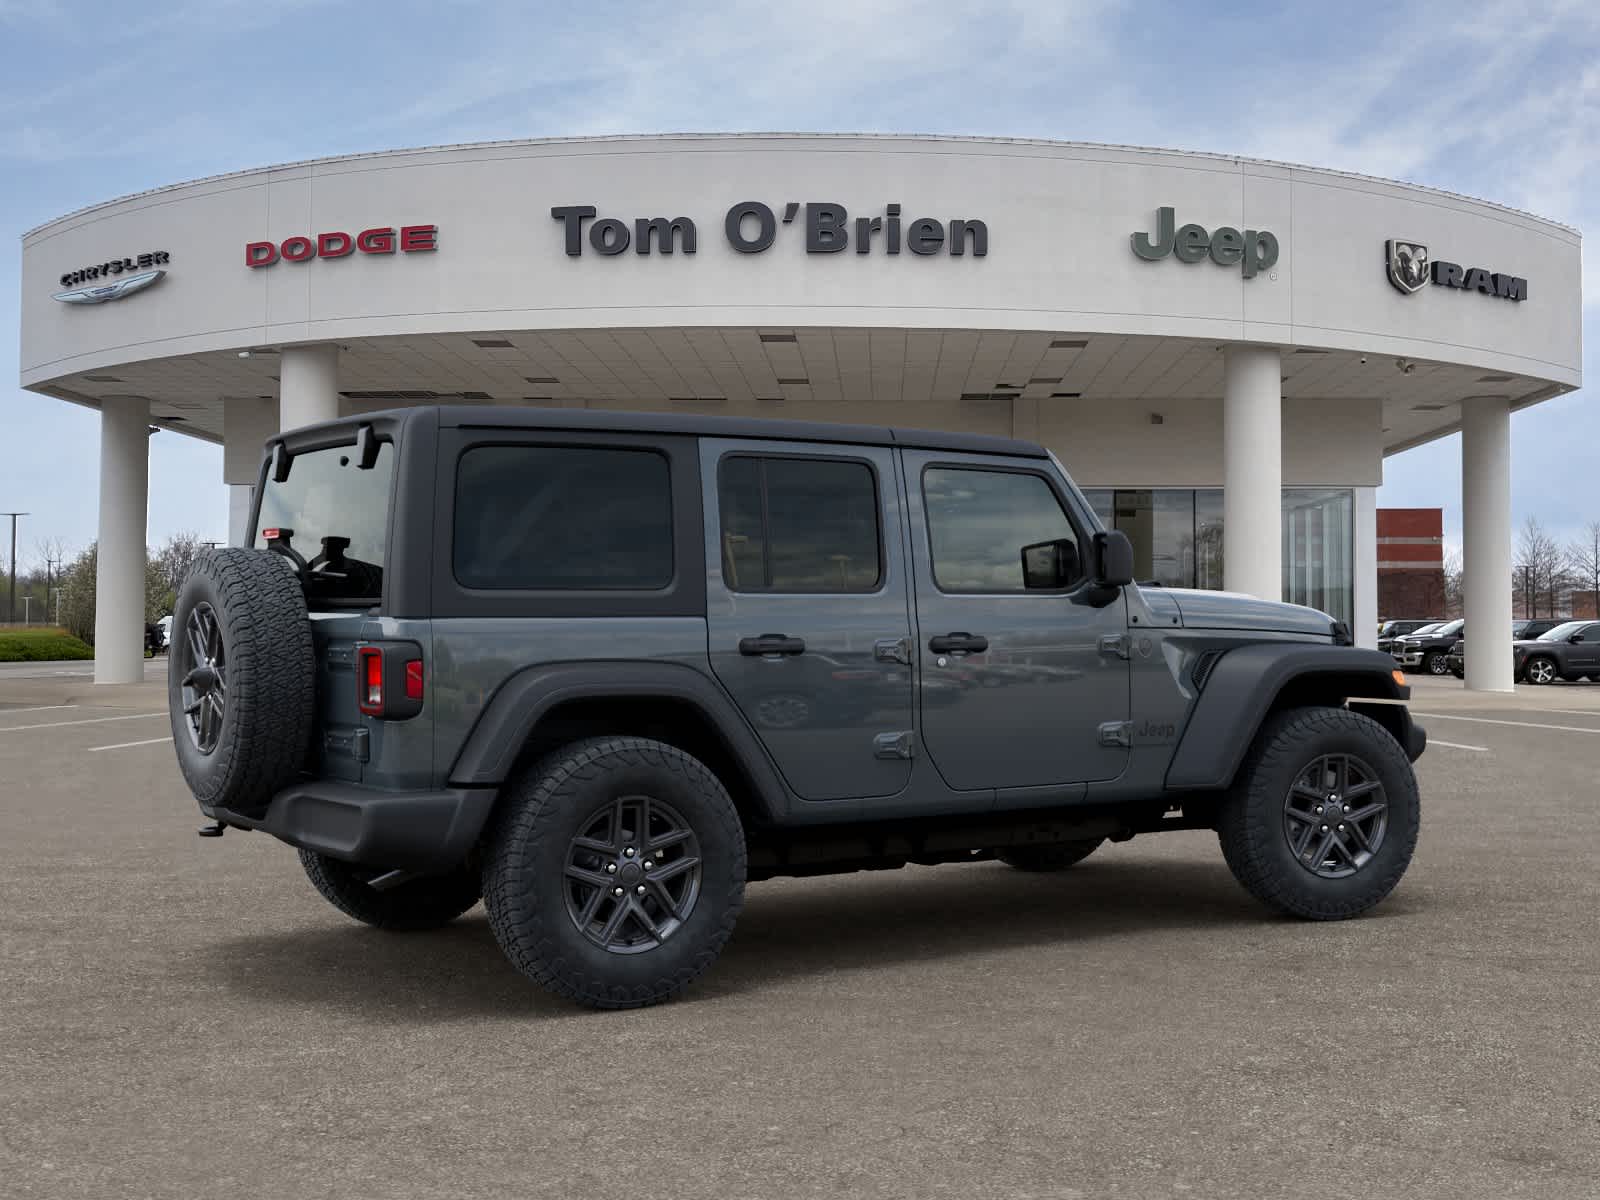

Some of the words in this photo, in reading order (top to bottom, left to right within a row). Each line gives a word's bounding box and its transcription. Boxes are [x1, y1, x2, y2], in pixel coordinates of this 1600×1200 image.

[245, 224, 438, 268] DODGE
[551, 205, 697, 256] Tom
[724, 201, 988, 257] O'Brien
[1130, 206, 1280, 279] Jeep
[59, 250, 170, 288] CHRYSLER
[1430, 260, 1528, 302] RAM
